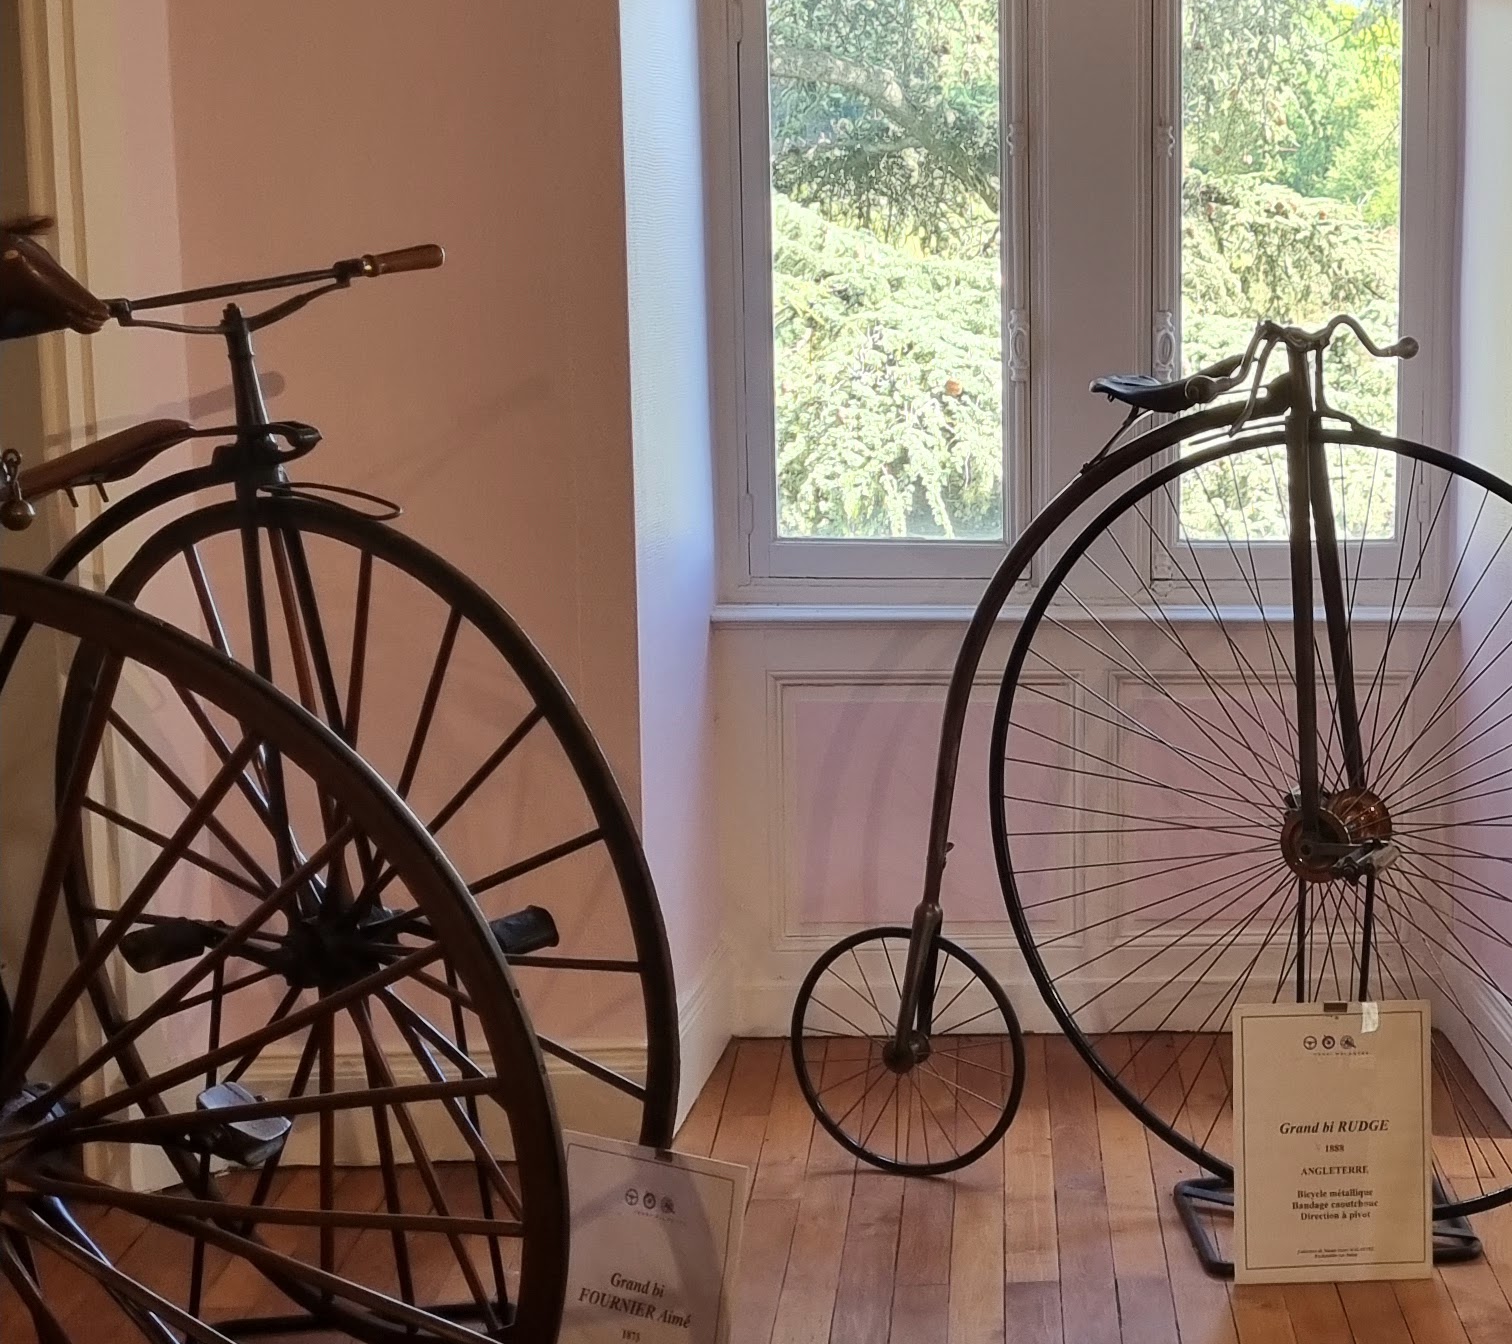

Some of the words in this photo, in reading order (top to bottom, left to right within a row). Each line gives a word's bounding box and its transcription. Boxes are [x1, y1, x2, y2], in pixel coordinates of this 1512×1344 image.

[1279, 1121, 1320, 1134] Grand
[1322, 1121, 1334, 1133] bi
[1338, 1119, 1390, 1132] RUDGE
[1300, 1165, 1369, 1176] ANGLETERRE
[1297, 1190, 1327, 1199] Bicycle
[1329, 1189, 1373, 1198] métallique
[1292, 1201, 1328, 1210] Bandage
[1301, 1212, 1339, 1220] Direction
[610, 1272, 650, 1294] Grand
[652, 1282, 665, 1297] bi
[578, 1288, 656, 1319] FOURNIER
[658, 1310, 692, 1328] Aimé
